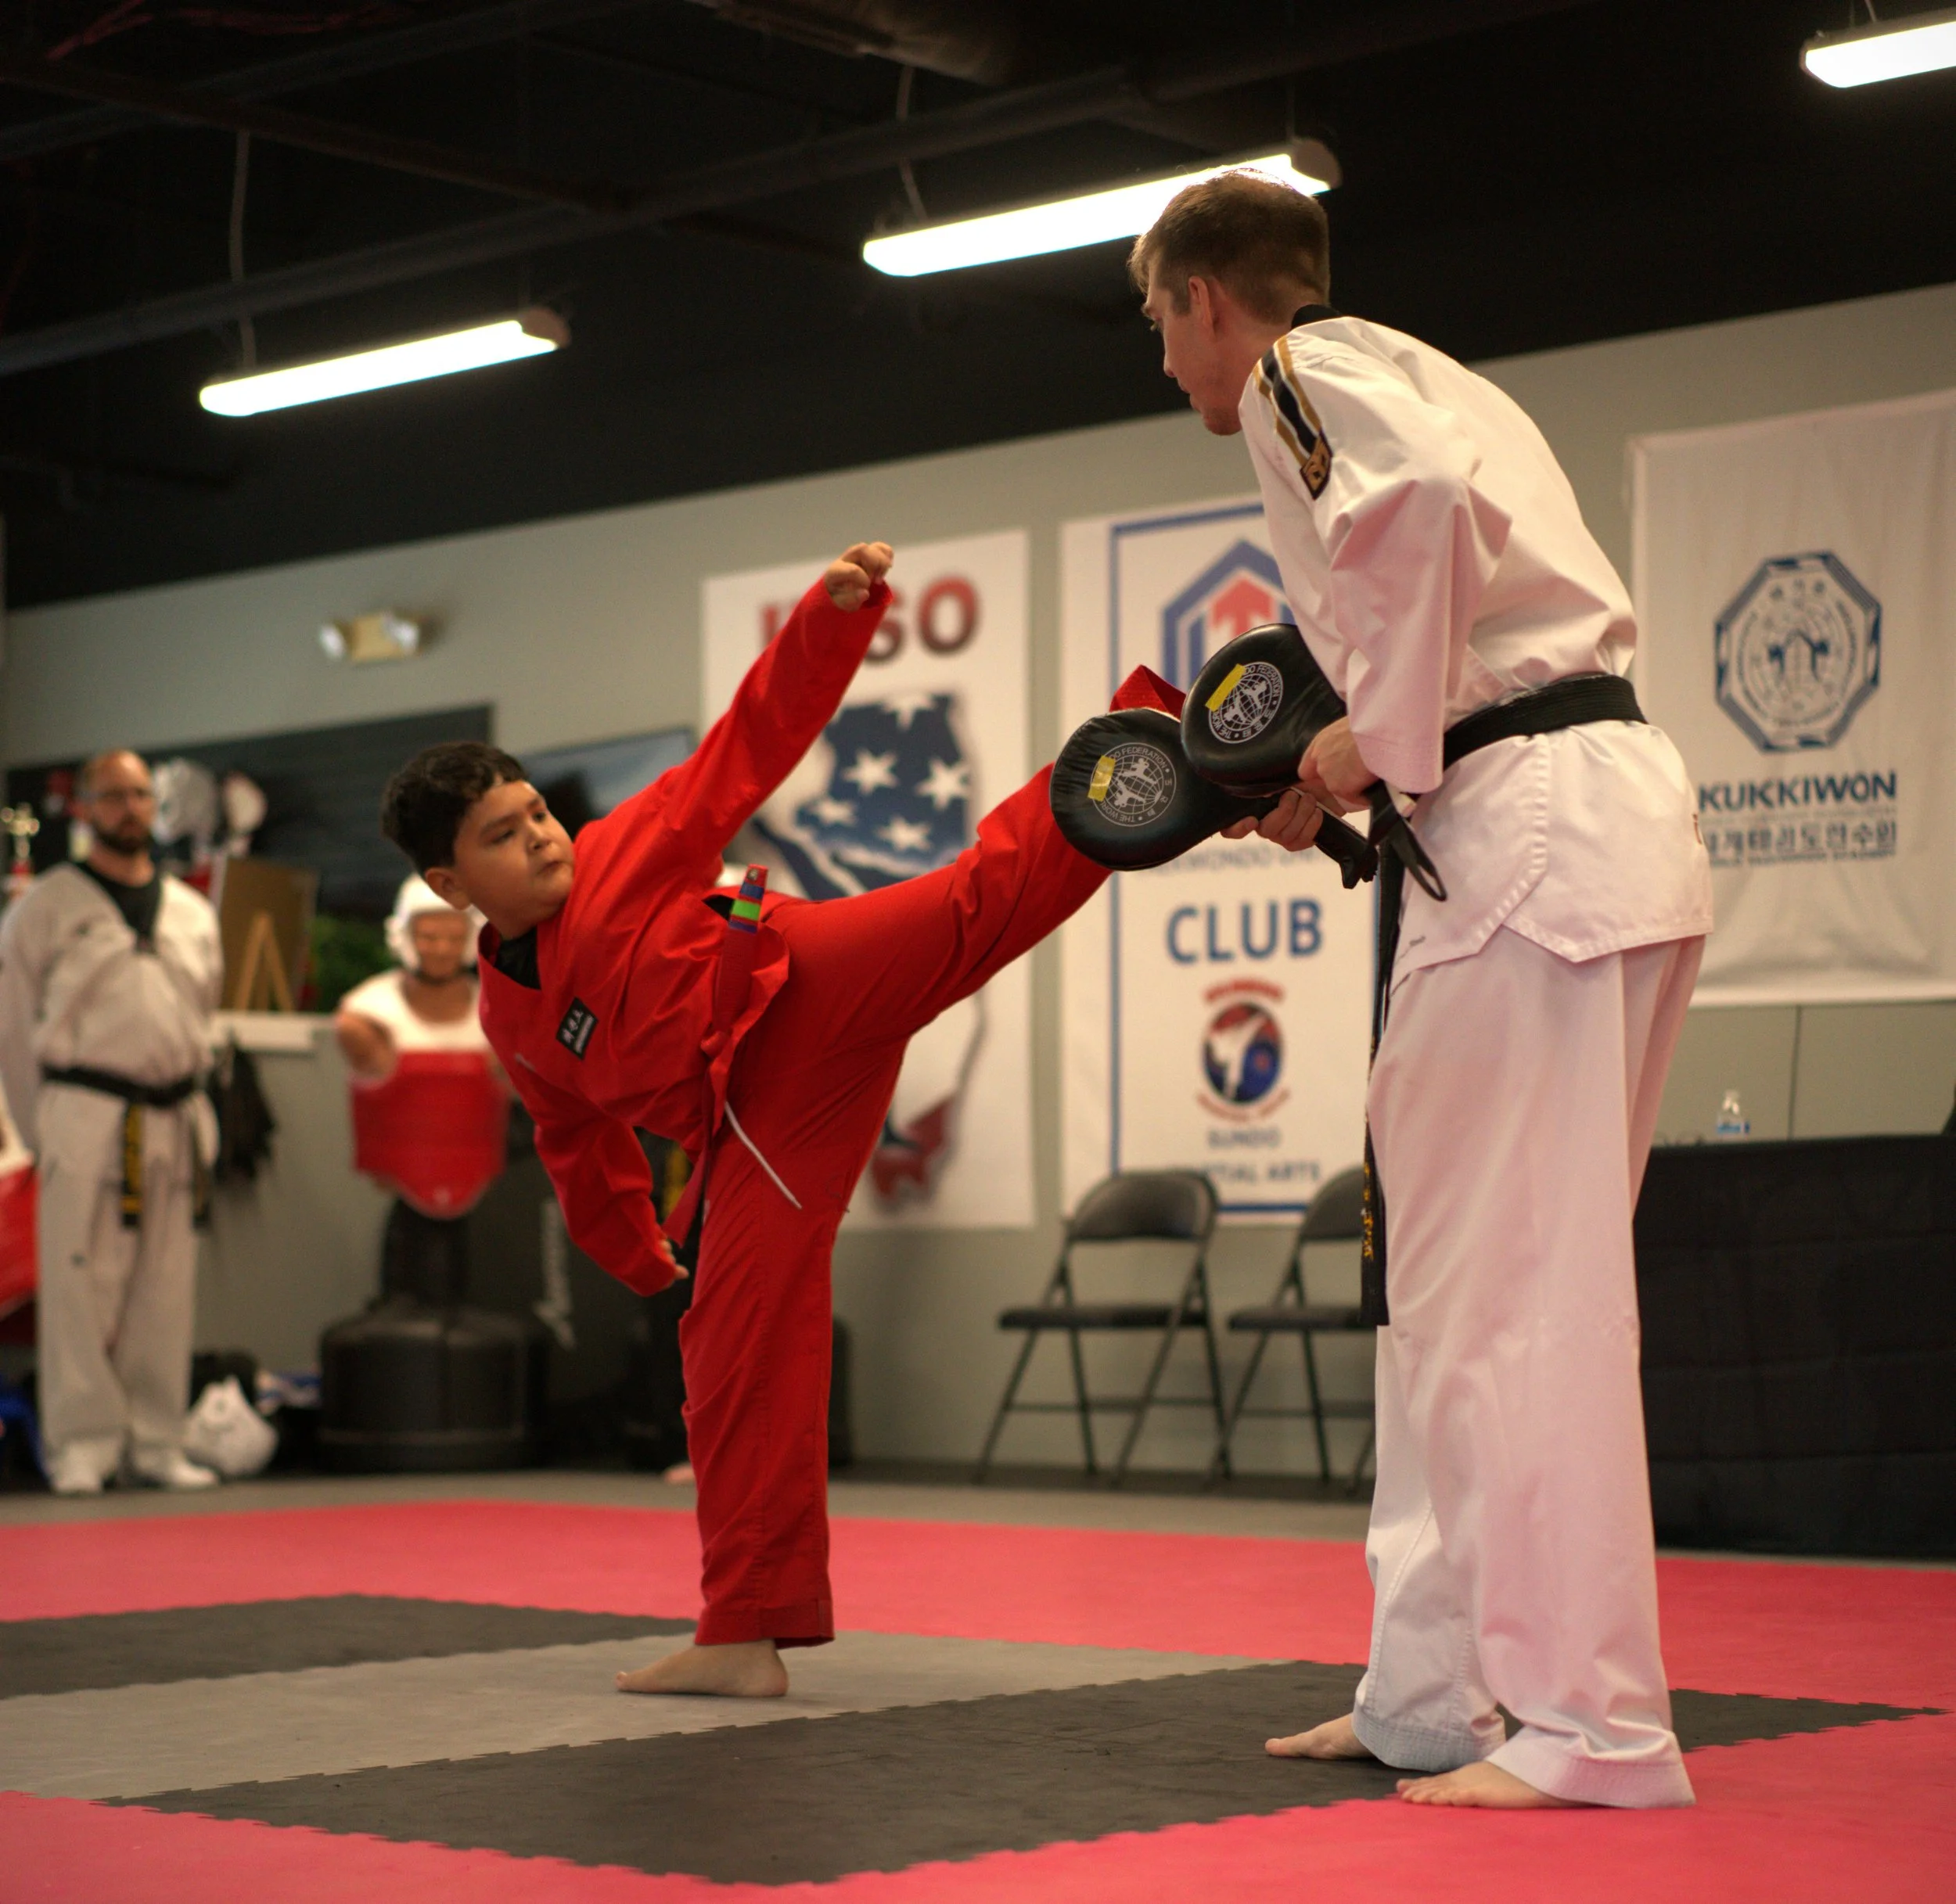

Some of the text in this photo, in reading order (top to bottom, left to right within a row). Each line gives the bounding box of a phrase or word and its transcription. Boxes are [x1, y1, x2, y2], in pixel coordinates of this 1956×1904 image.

[1121, 746, 1168, 770] FEDERATION
[1699, 771, 1897, 812] KUKKIWON
[1119, 814, 1135, 823] THE
[1167, 899, 1324, 965] CLUB
